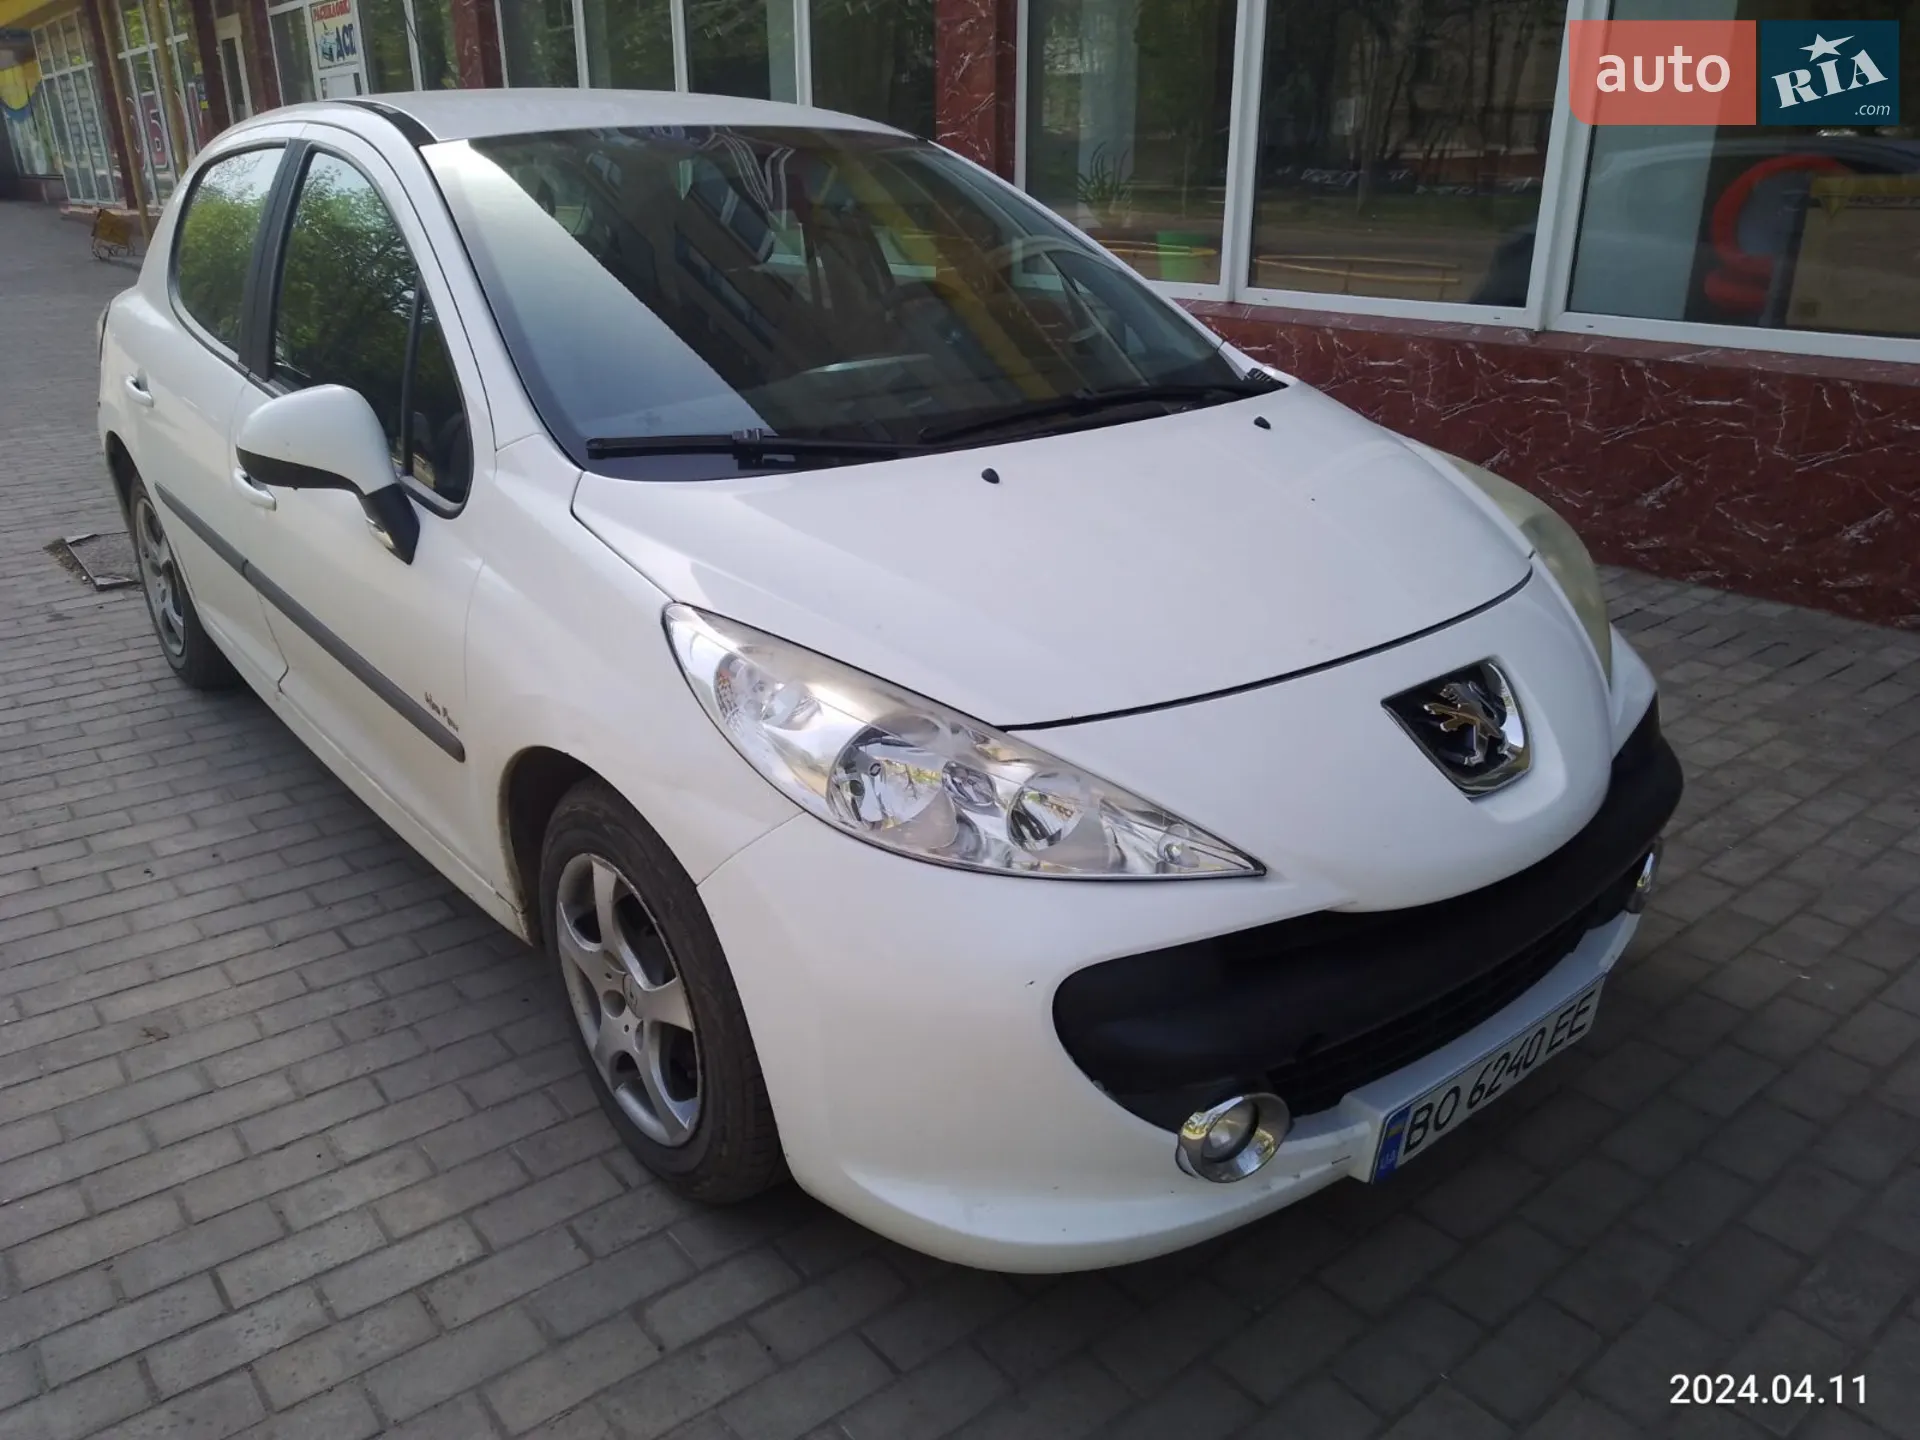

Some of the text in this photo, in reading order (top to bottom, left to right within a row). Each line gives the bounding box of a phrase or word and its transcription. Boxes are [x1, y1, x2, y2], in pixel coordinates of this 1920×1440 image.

[1403, 989, 1596, 1156] BO 6240 EE
